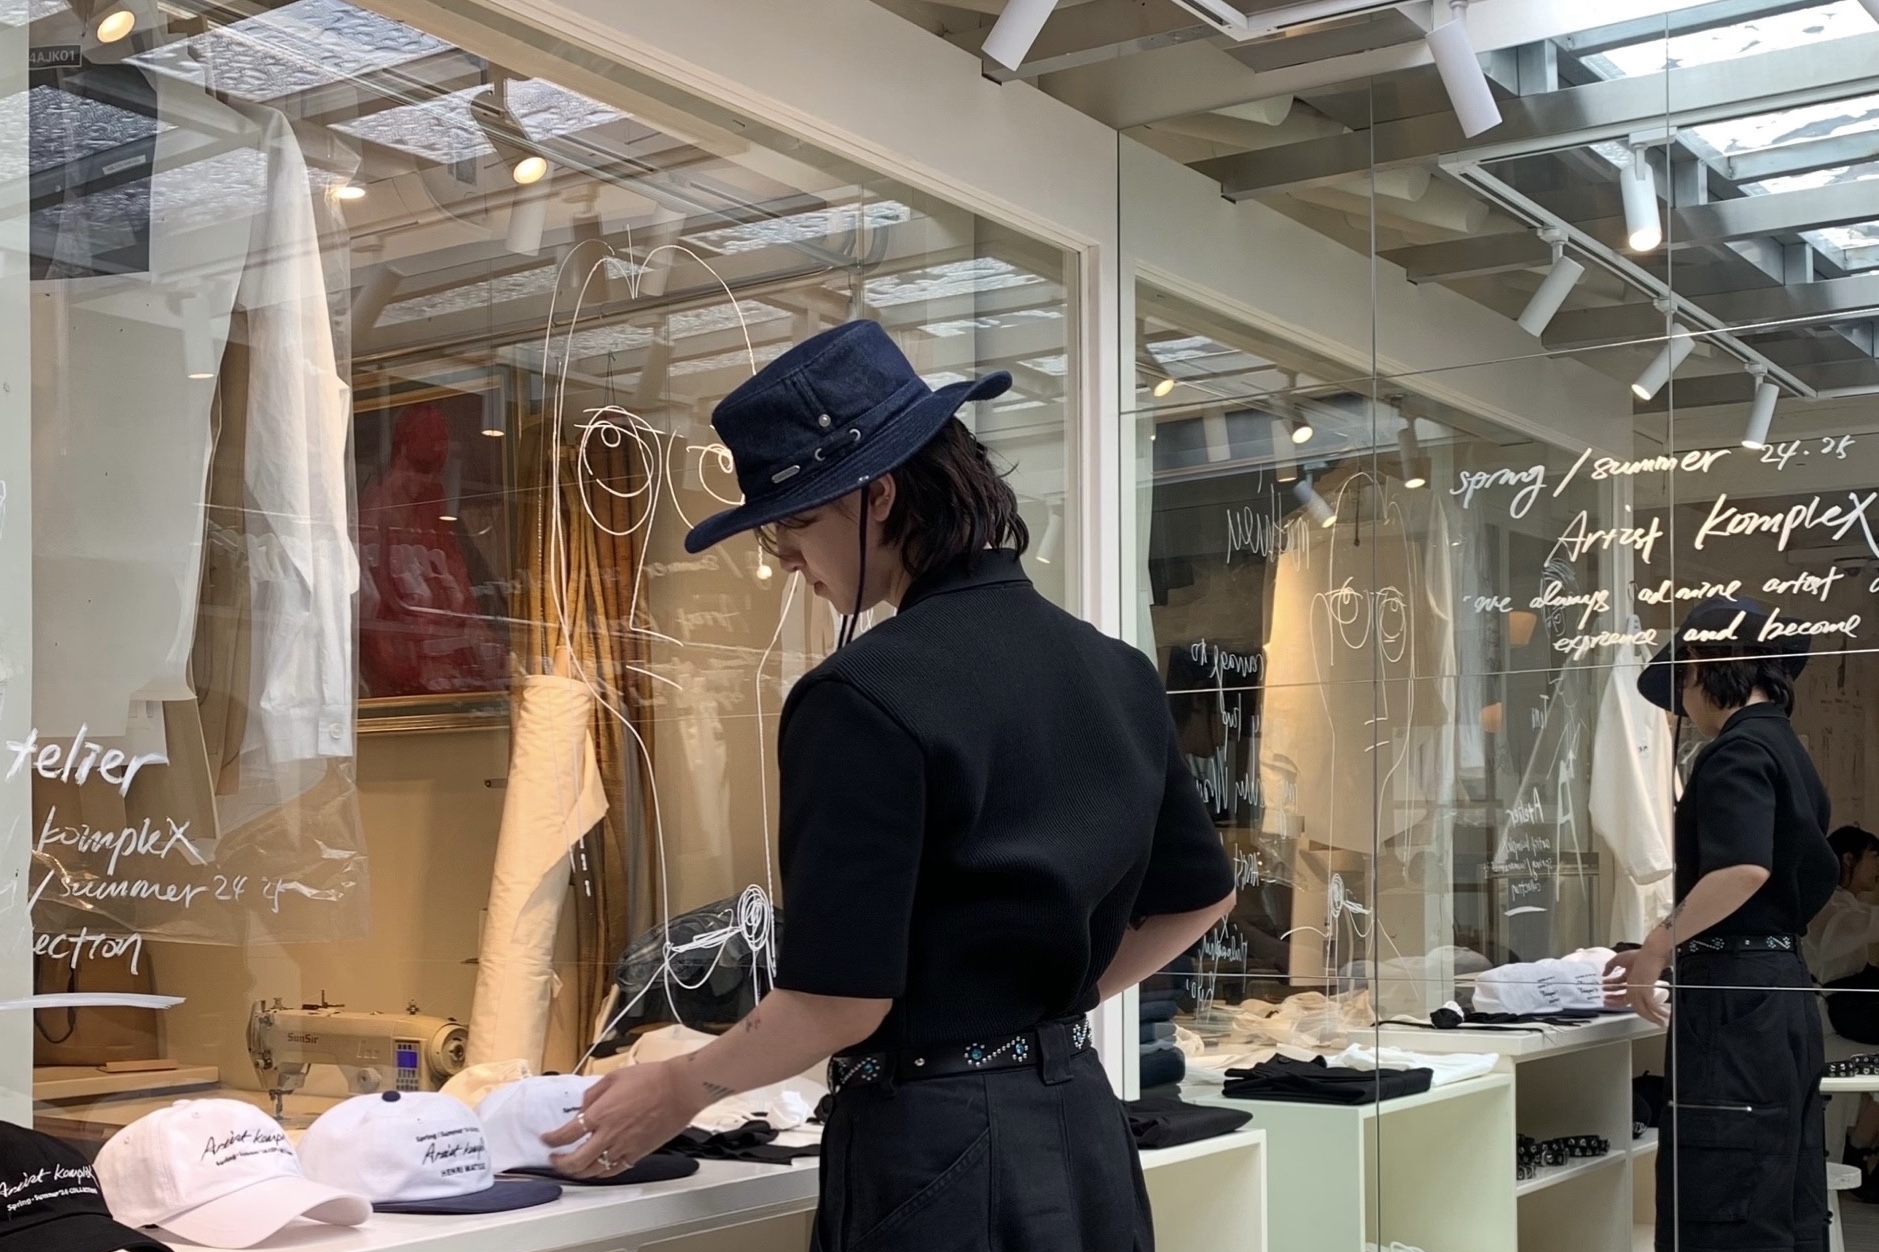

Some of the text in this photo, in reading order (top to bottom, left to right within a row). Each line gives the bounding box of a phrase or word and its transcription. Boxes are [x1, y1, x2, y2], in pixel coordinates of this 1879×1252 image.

[1544, 504, 1664, 567] Artist
[1762, 566, 1844, 602] artist
[1683, 610, 1747, 643] and
[1758, 607, 1862, 643] become
[213, 874, 248, 901] 24
